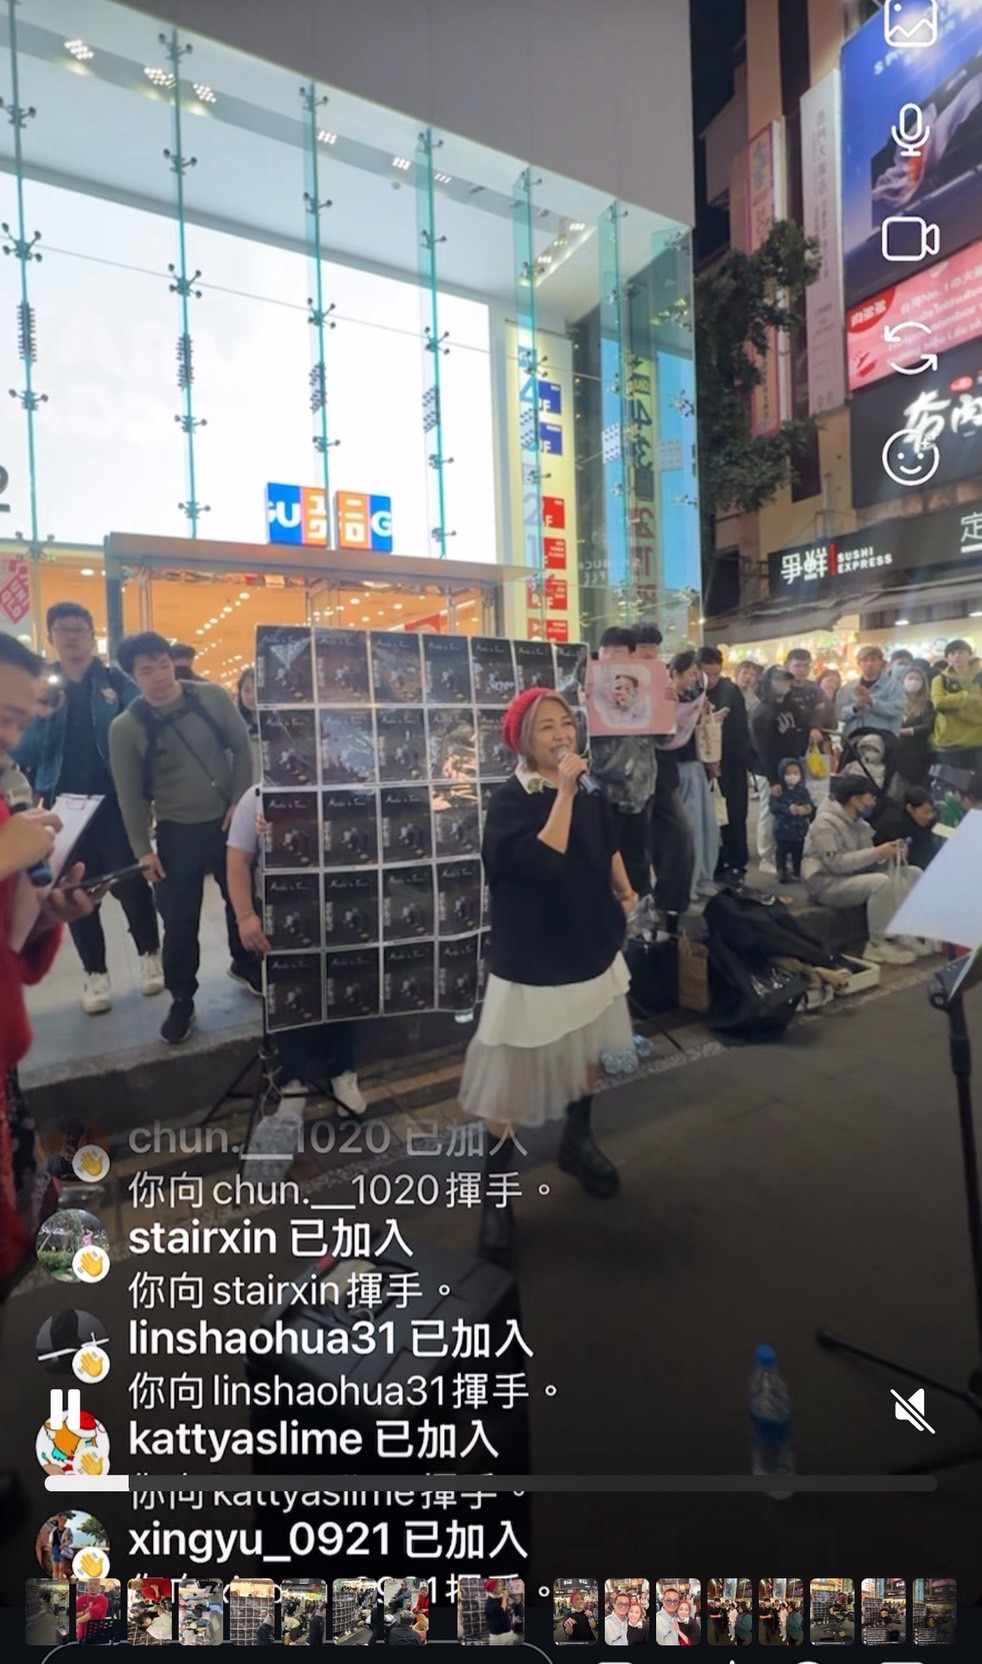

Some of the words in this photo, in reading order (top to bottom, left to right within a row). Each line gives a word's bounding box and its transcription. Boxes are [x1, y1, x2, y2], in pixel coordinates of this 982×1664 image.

[837, 546, 874, 563] SUSHI
[837, 553, 893, 574] EXPRESS
[780, 546, 829, 585] 爭鮮
